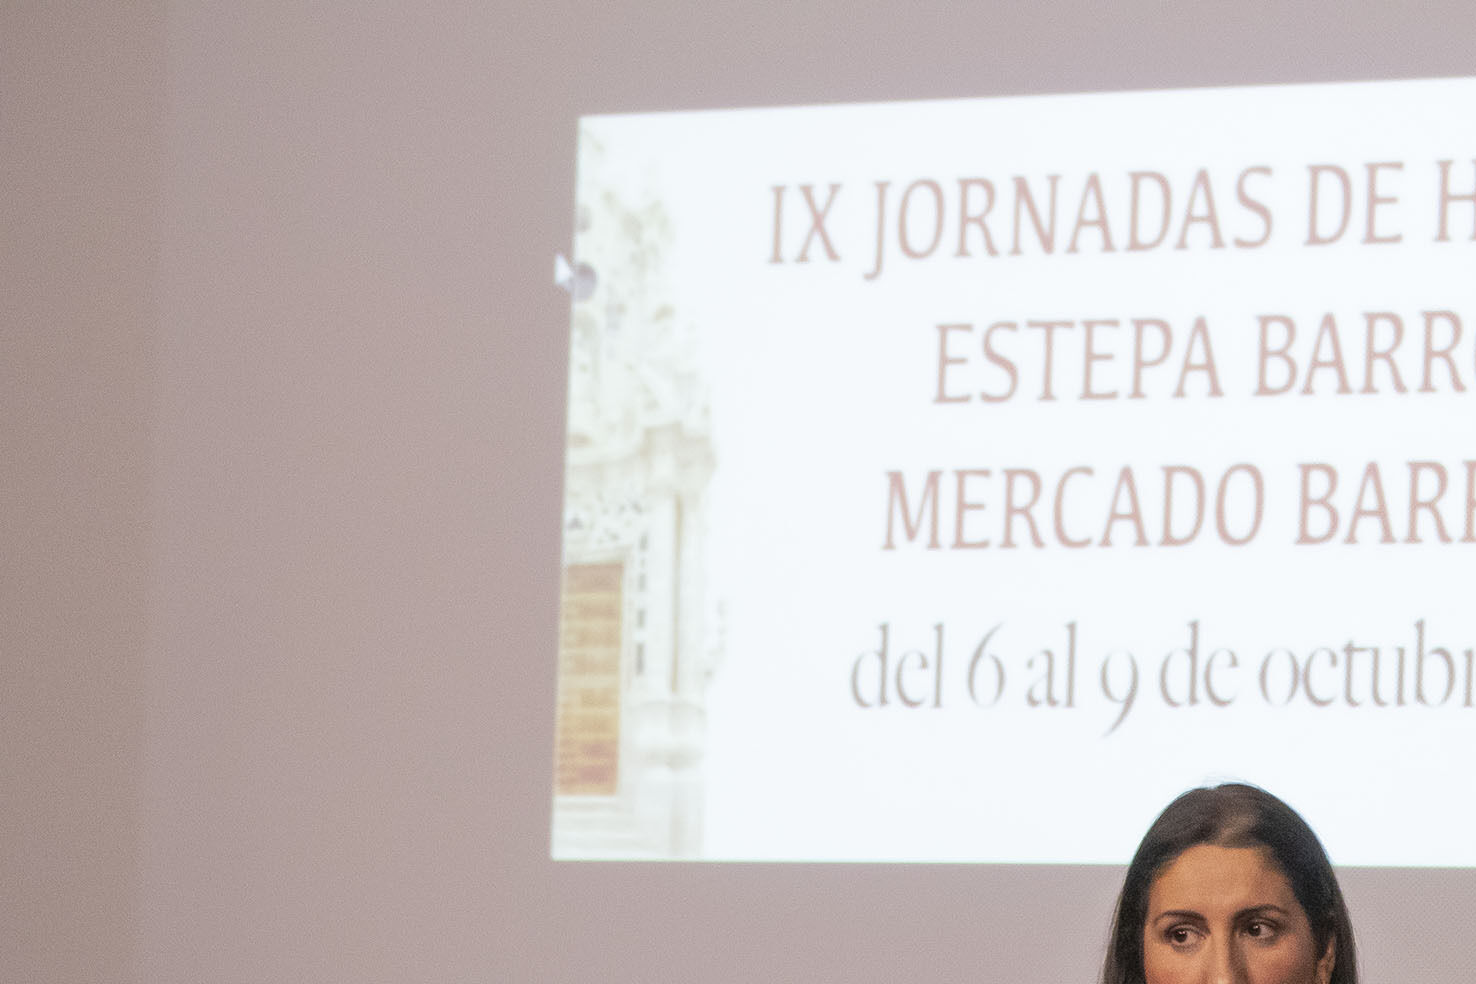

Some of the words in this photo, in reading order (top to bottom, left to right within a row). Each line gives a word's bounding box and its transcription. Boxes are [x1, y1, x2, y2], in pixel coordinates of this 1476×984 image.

[768, 183, 842, 265] IX
[863, 165, 1273, 282] JORNADAS
[1303, 161, 1405, 247] DE
[933, 315, 1225, 405] ESTEPA
[882, 462, 1265, 551] MERCADO
[849, 621, 945, 709] del
[966, 621, 1006, 708] 6
[1025, 620, 1077, 709] al
[1099, 648, 1140, 738] 9
[1158, 619, 1239, 708] de
